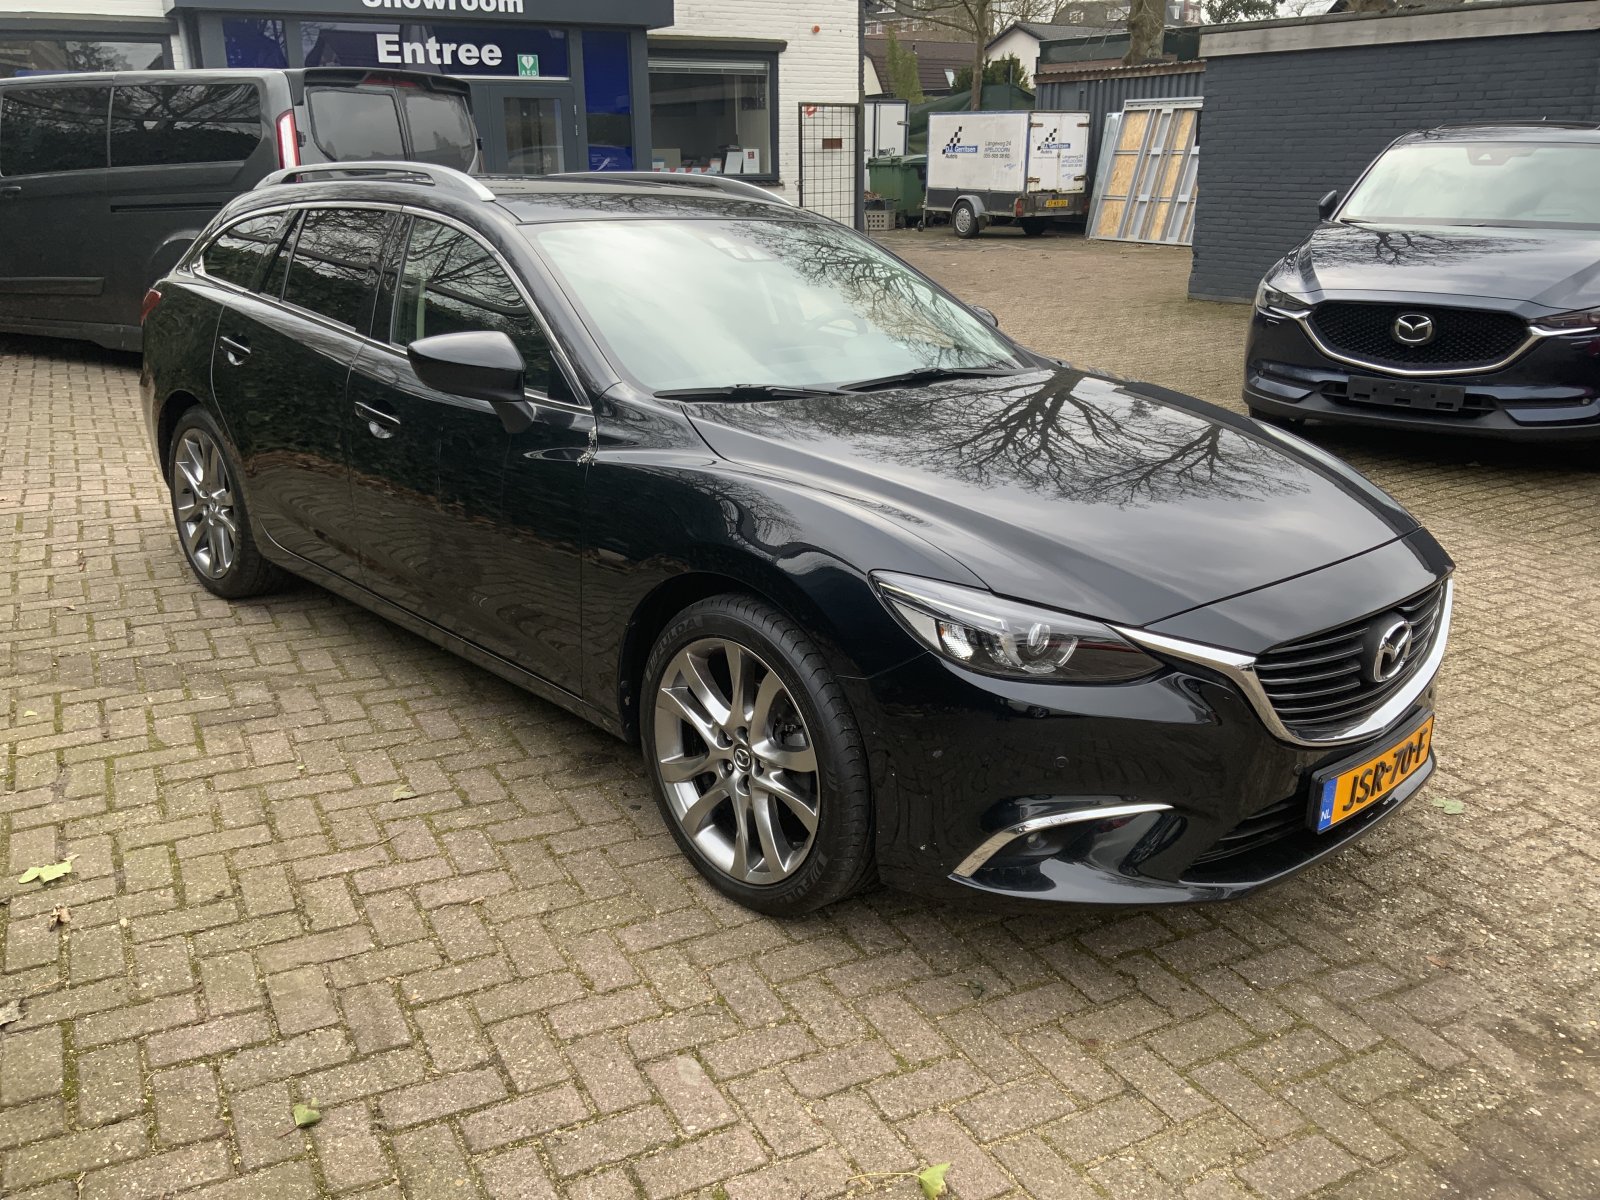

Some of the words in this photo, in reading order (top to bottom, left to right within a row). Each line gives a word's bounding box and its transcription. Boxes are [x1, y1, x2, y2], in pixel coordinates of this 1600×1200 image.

[376, 33, 502, 66] Entree
[954, 145, 976, 153] Gerritsen
[1342, 727, 1429, 812] JSR-70-F
[1320, 809, 1331, 822] NL
